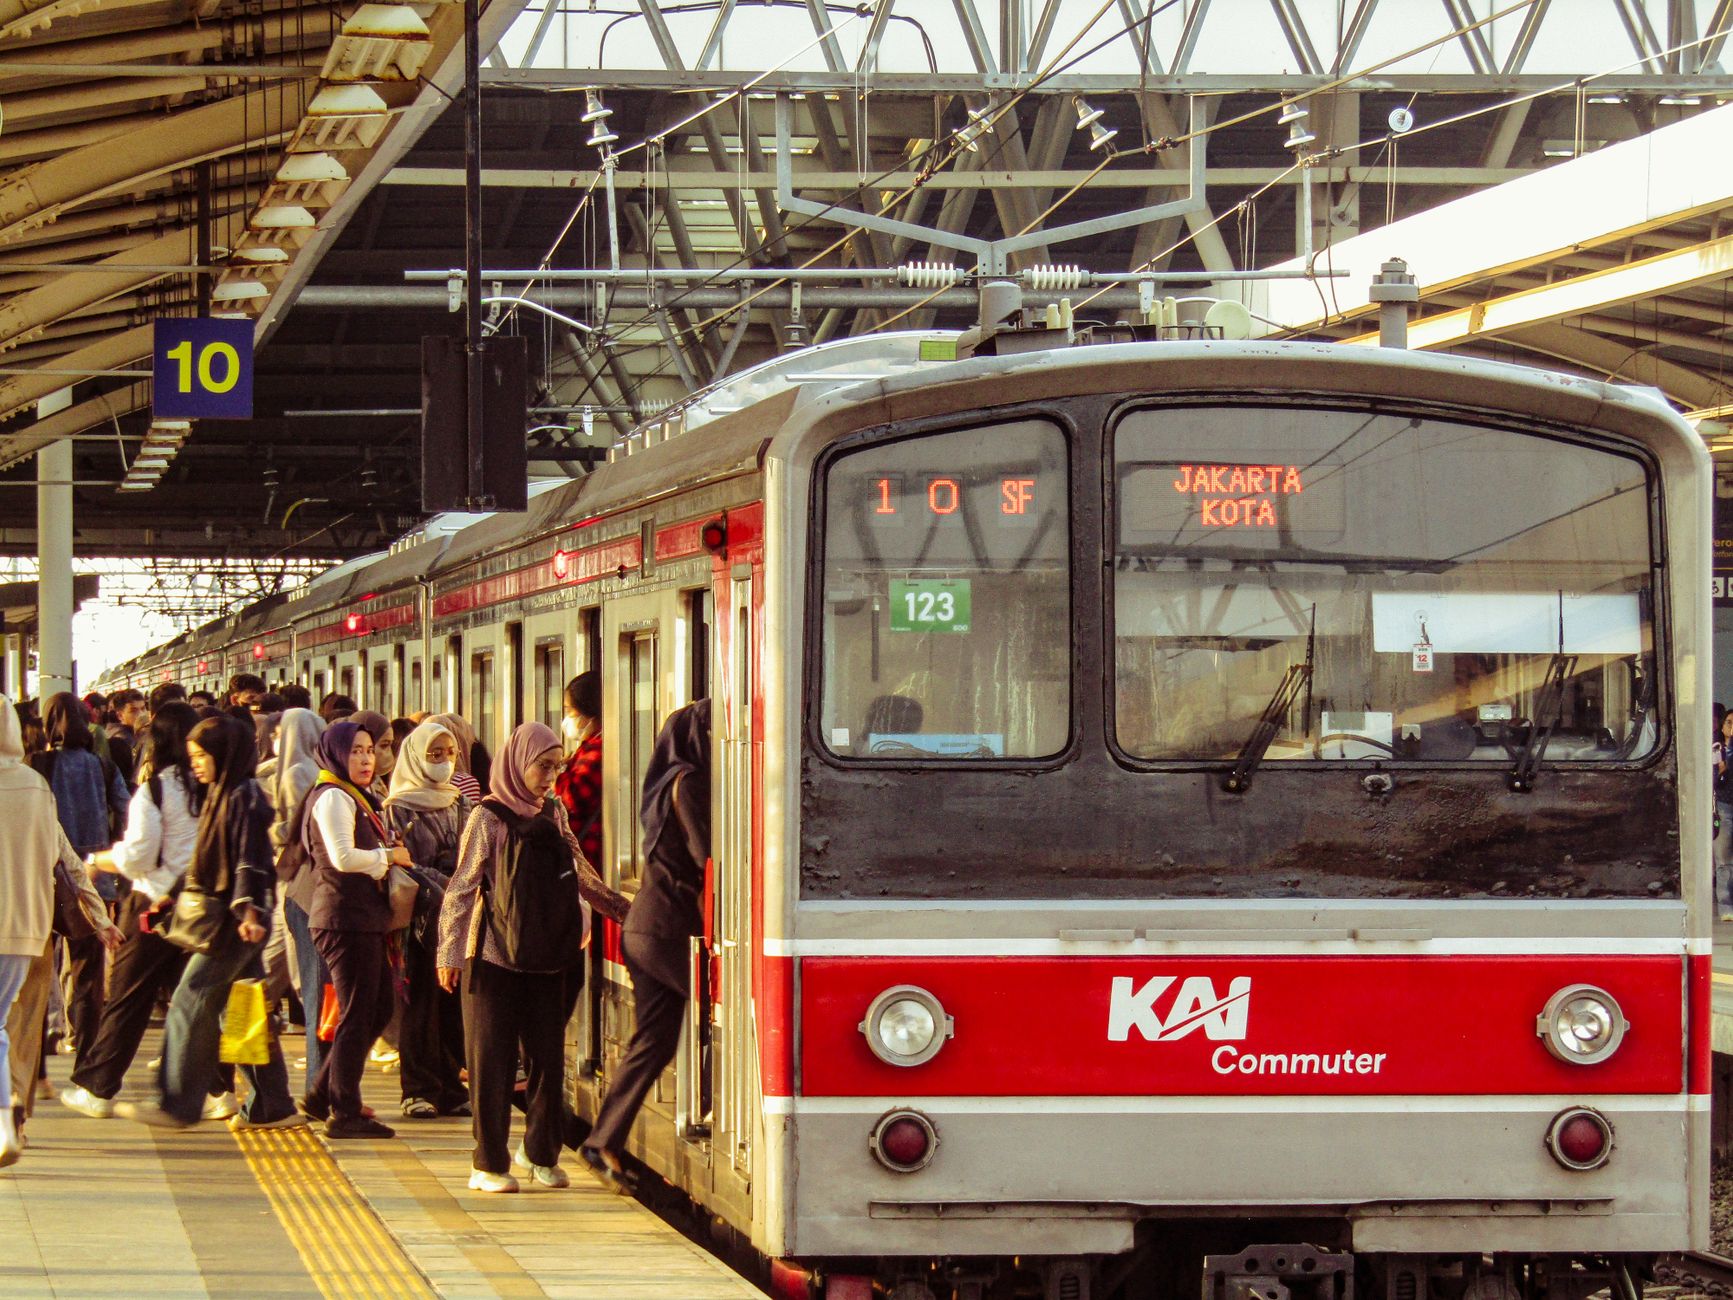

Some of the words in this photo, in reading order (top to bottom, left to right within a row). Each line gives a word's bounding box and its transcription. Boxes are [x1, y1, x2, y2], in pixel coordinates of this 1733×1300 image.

[167, 341, 240, 393] 10
[1174, 465, 1302, 493] JAKARTA
[1001, 479, 1035, 514] SF
[1202, 498, 1276, 526] KOTA
[905, 592, 954, 622] 123
[1107, 976, 1252, 1041] KAI
[1211, 1045, 1386, 1074] Commuter
